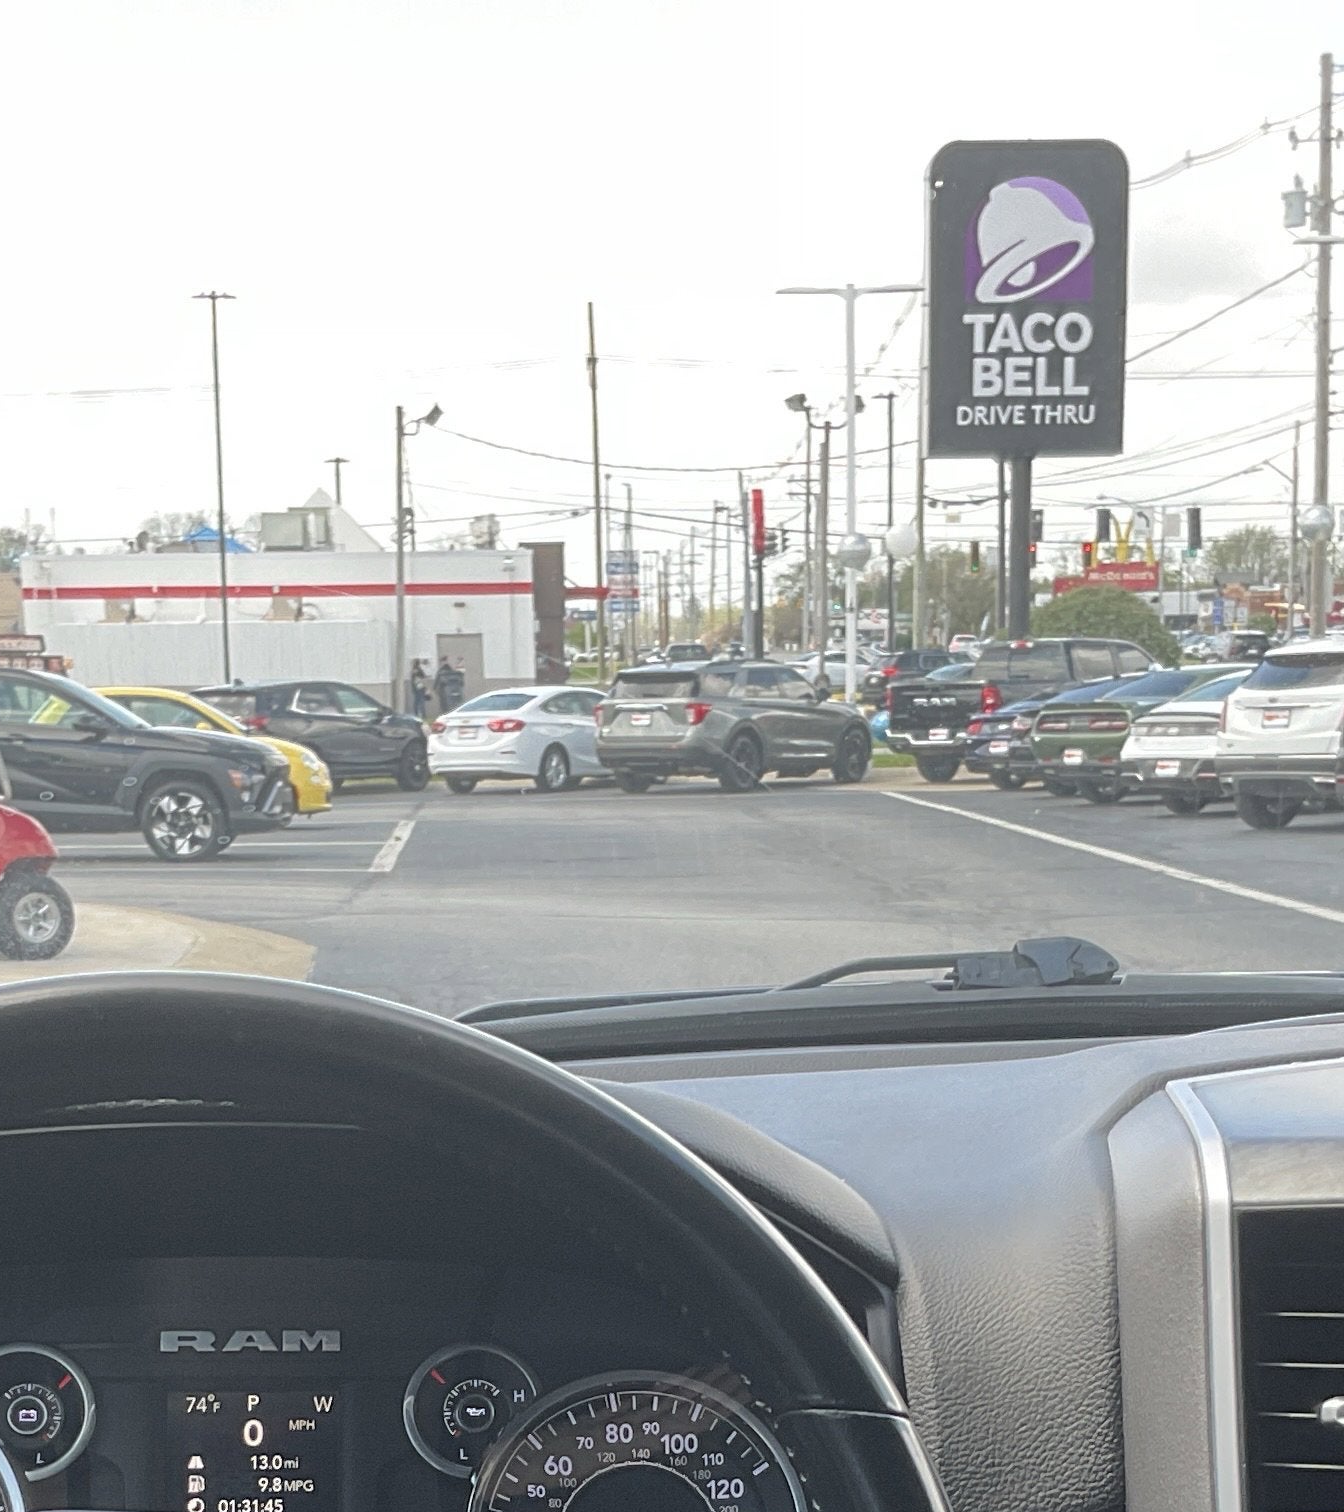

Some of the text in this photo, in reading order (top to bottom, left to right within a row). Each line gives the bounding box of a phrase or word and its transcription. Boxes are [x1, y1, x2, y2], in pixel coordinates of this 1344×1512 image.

[962, 311, 1094, 353] TACO
[972, 356, 1089, 397] BELL
[956, 404, 1096, 426] DRIVE THRU
[159, 1330, 341, 1353] RAM
[247, 1394, 260, 1412] P
[313, 1396, 333, 1413] W
[512, 1389, 526, 1404] H
[243, 1419, 316, 1447] 0 MPH
[605, 1423, 634, 1444] 80
[642, 1421, 660, 1436] 90
[575, 1436, 594, 1451] 70
[660, 1433, 699, 1455] 100
[35, 1452, 45, 1465] L
[459, 1448, 469, 1461] L
[596, 1451, 616, 1463] 120
[631, 1448, 651, 1460] 140
[669, 1455, 688, 1468] 160
[701, 1453, 725, 1467] 110
[544, 1456, 573, 1477] 60
[558, 1477, 578, 1489] 100
[706, 1479, 745, 1500] 120
[527, 1485, 546, 1499] 50
